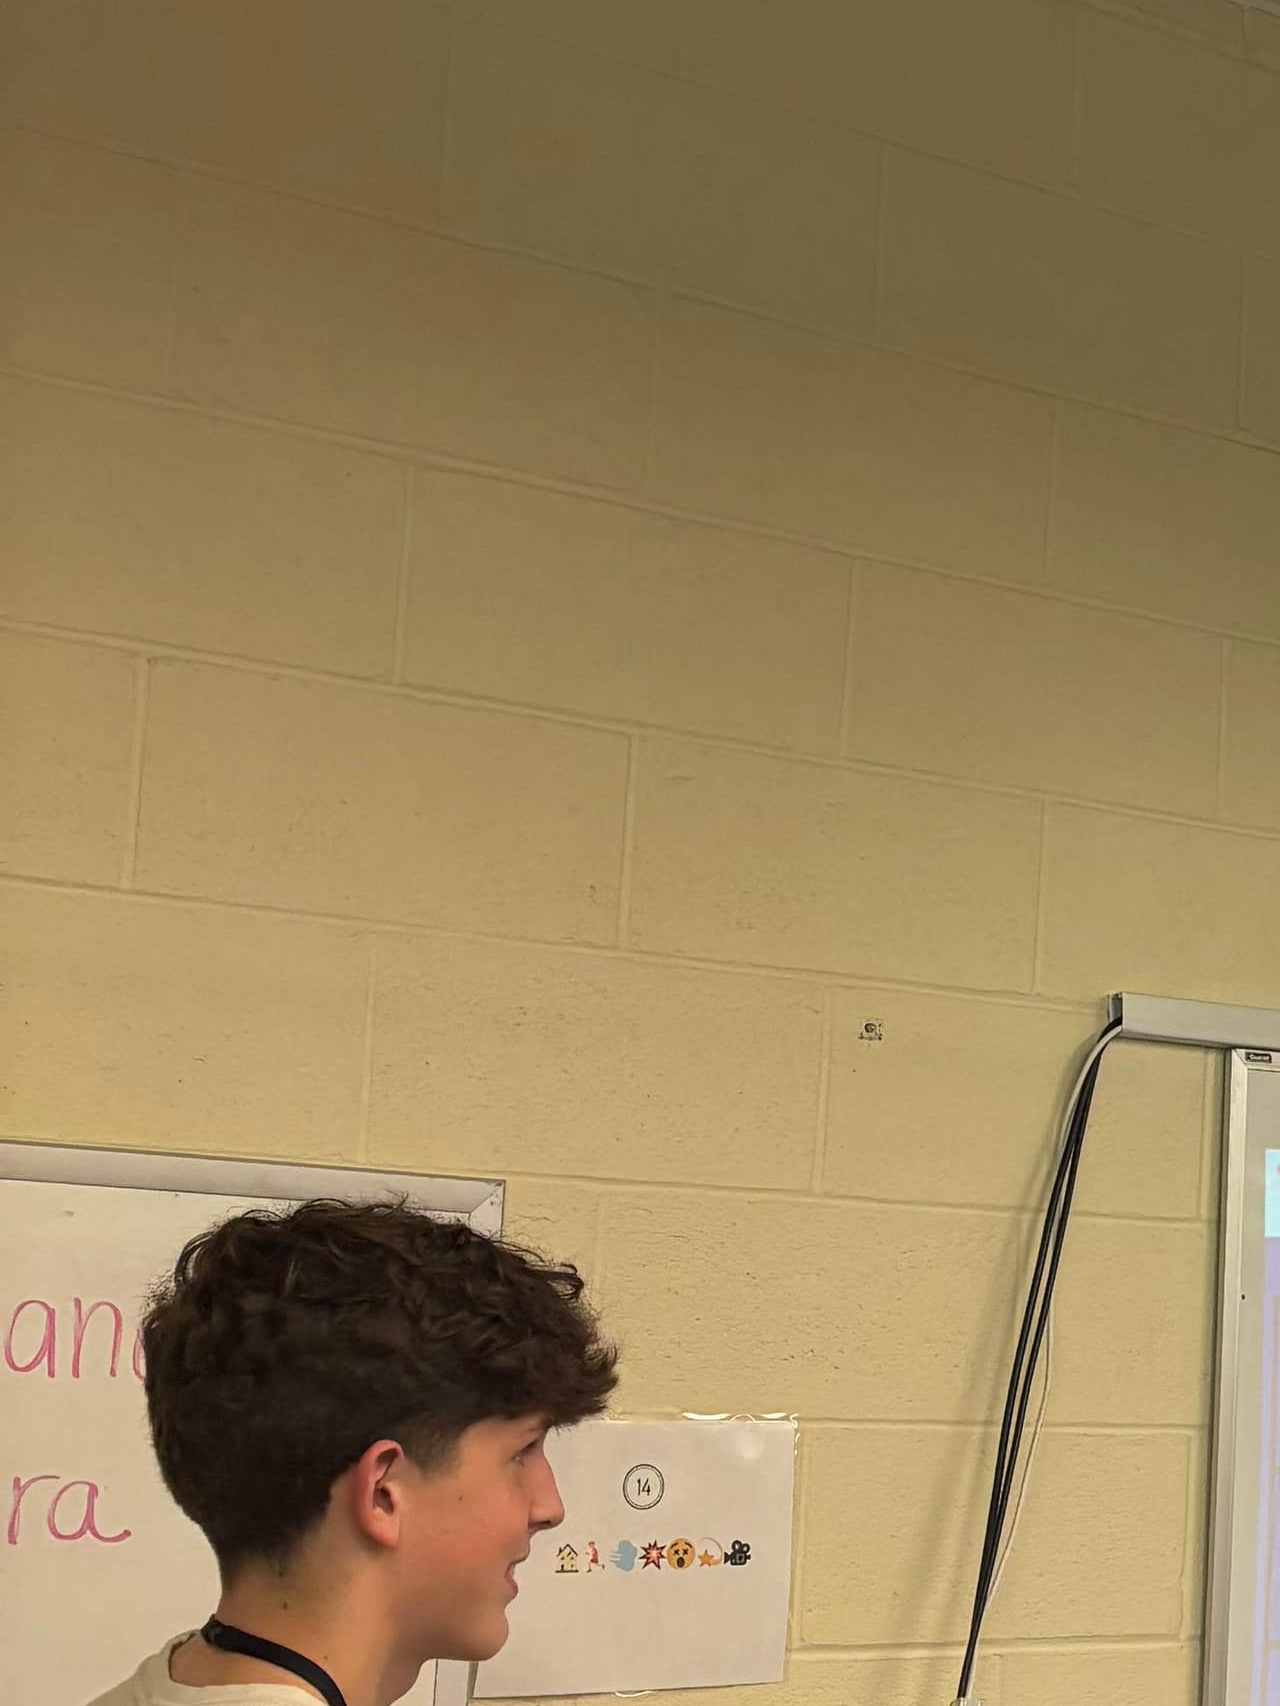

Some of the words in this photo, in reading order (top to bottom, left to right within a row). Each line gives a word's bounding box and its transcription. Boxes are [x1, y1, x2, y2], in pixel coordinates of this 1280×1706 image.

[4, 1297, 146, 1382] an
[8, 1474, 132, 1546] ra
[636, 1477, 651, 1497] 14
